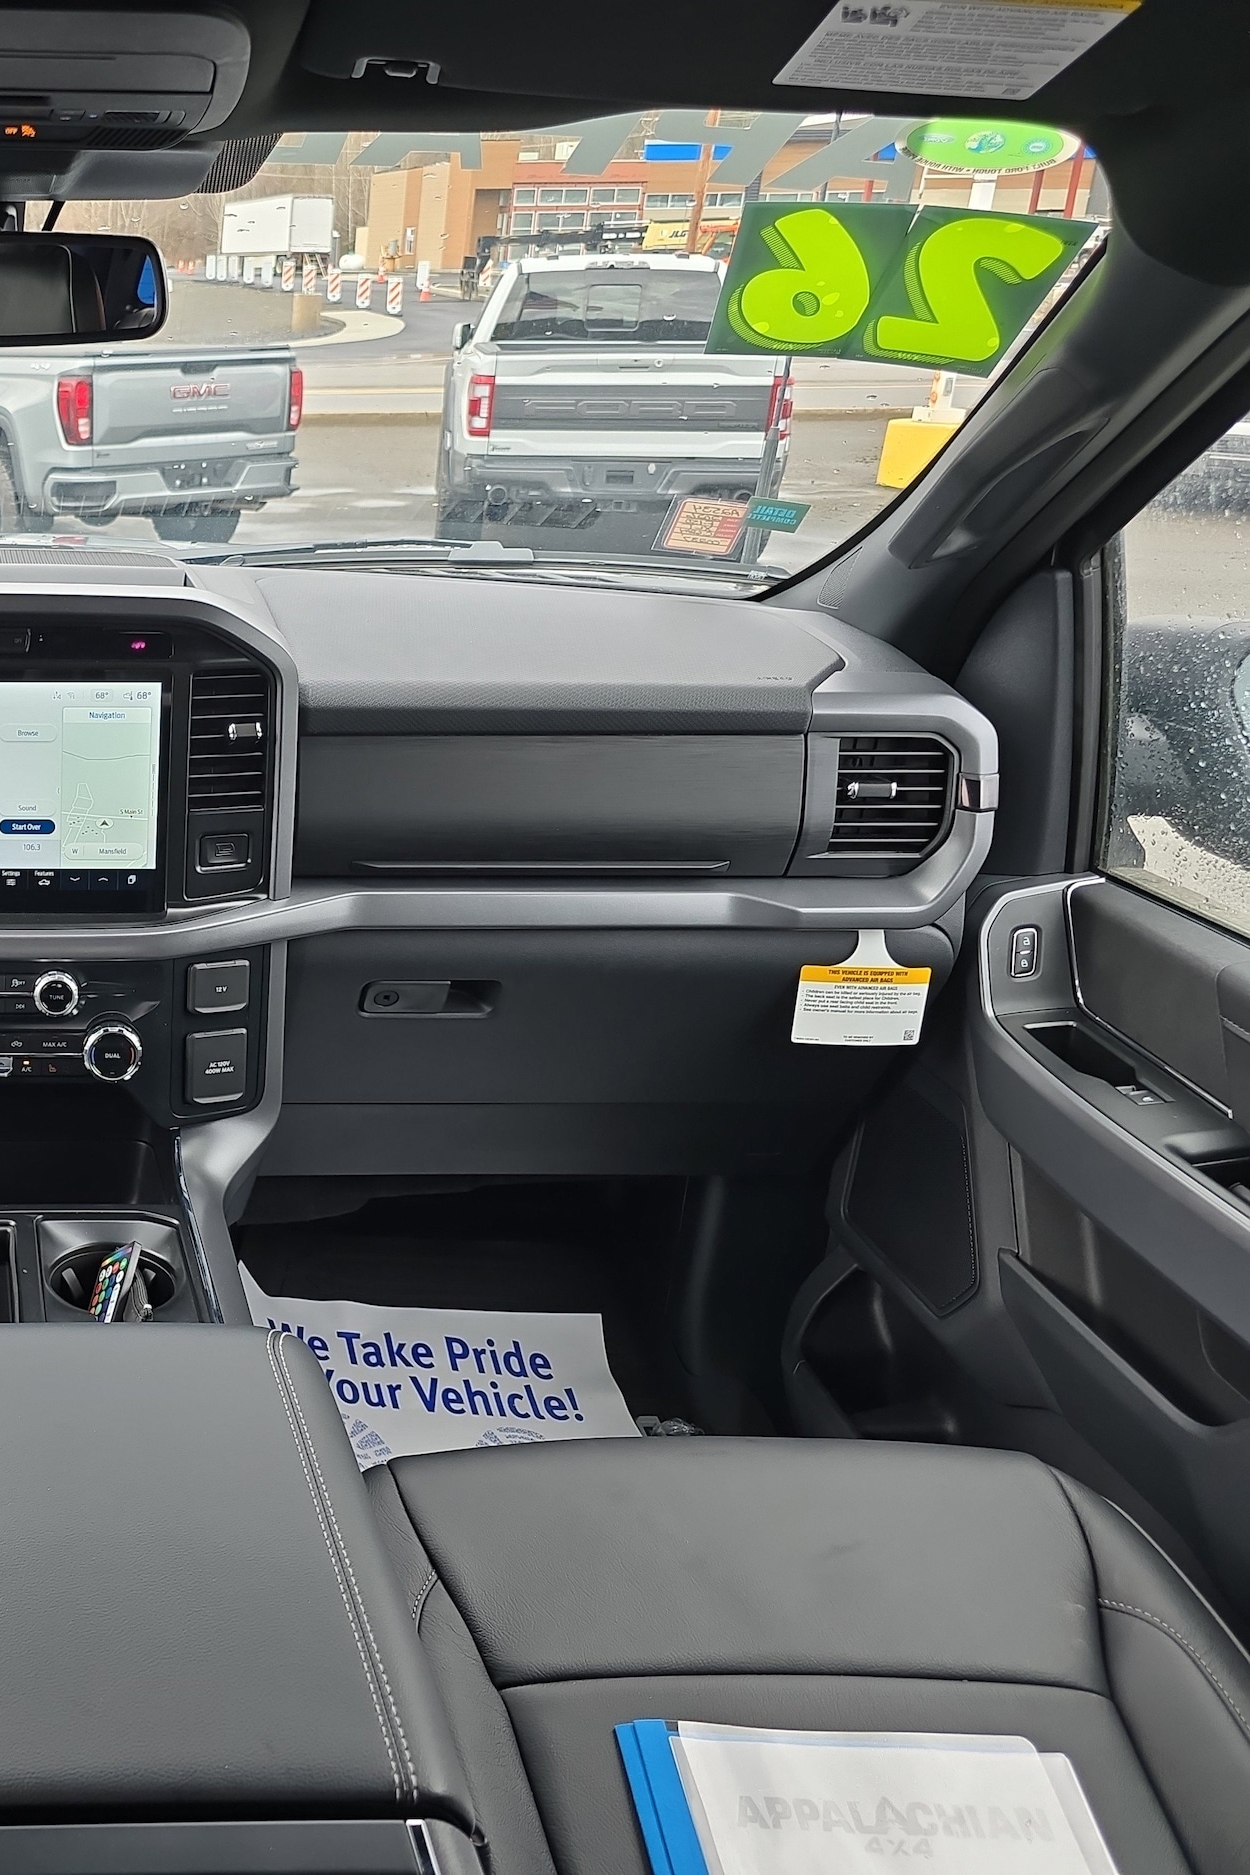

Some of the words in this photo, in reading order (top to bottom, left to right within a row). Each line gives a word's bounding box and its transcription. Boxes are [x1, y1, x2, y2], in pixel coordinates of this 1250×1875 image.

[5, 127, 18, 135] OFF
[669, 229, 690, 238] JLG
[171, 383, 230, 399] GMC
[524, 400, 737, 418] FORD
[95, 691, 109, 699] 68°
[136, 691, 152, 700] 68°
[89, 711, 126, 720] Navigation
[17, 729, 39, 737] Browse
[18, 804, 37, 812] Sound
[11, 823, 27, 831] Start
[27, 823, 42, 831] Over
[22, 843, 41, 851] 106.3
[217, 1060, 231, 1068] 120V
[205, 1067, 221, 1075] 400W
[335, 1330, 435, 1371] Take
[443, 1334, 555, 1381] Pride
[325, 1367, 402, 1410] our
[408, 1375, 585, 1423] Vehicle!
[737, 1795, 1056, 1841] APPALACHIAN
